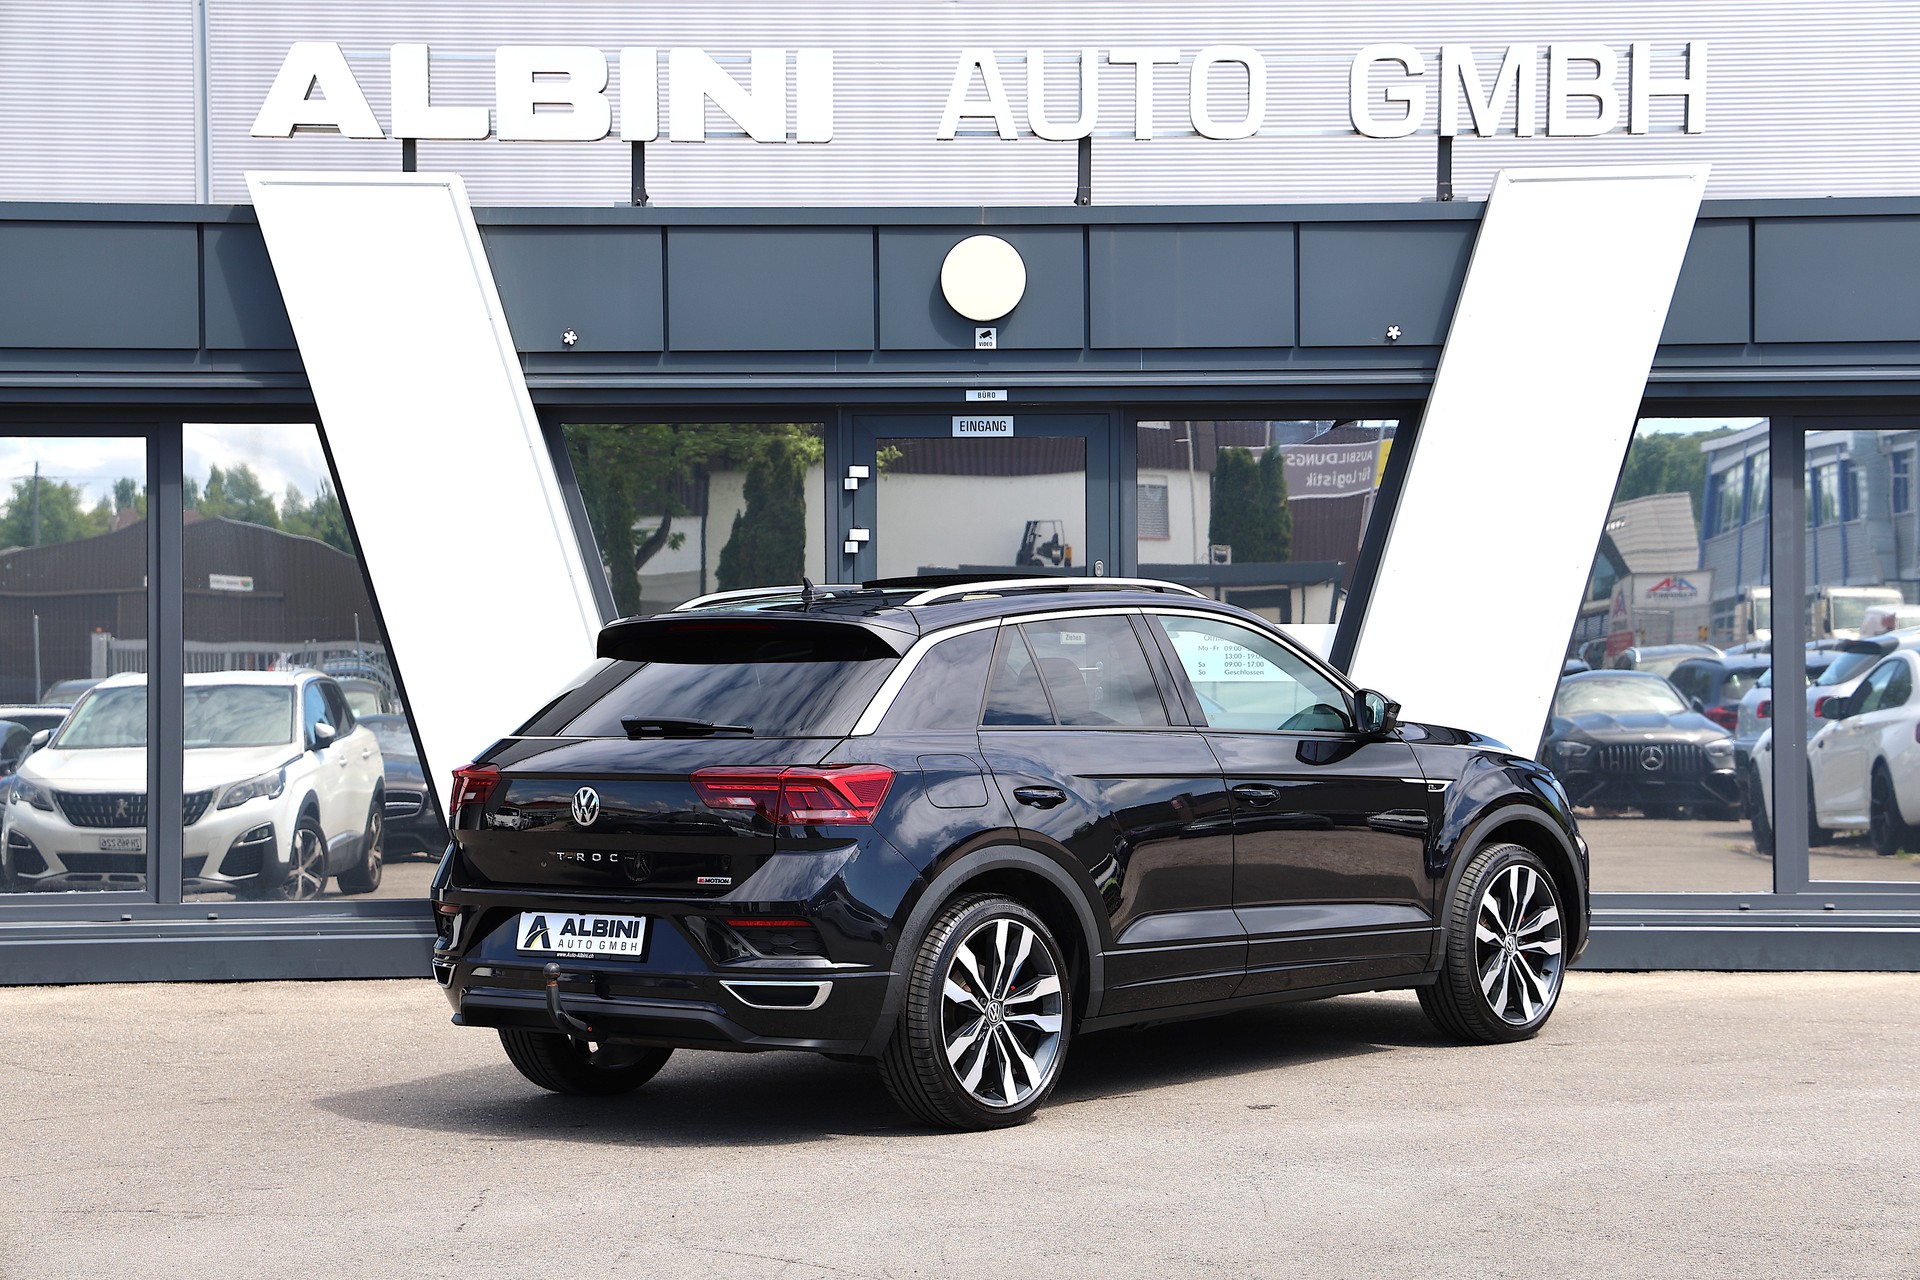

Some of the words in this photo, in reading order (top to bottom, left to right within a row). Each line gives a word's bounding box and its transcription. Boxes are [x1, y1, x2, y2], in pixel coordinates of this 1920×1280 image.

[250, 41, 834, 144] ALBINI
[936, 45, 1267, 142] AUTO
[1348, 39, 1708, 138] GMBH
[977, 391, 996, 399] BÜRO
[960, 420, 1007, 432] EINGANG
[560, 918, 640, 939] ALBINI
[557, 939, 593, 950] AUTO
[599, 940, 638, 951] GMBH
